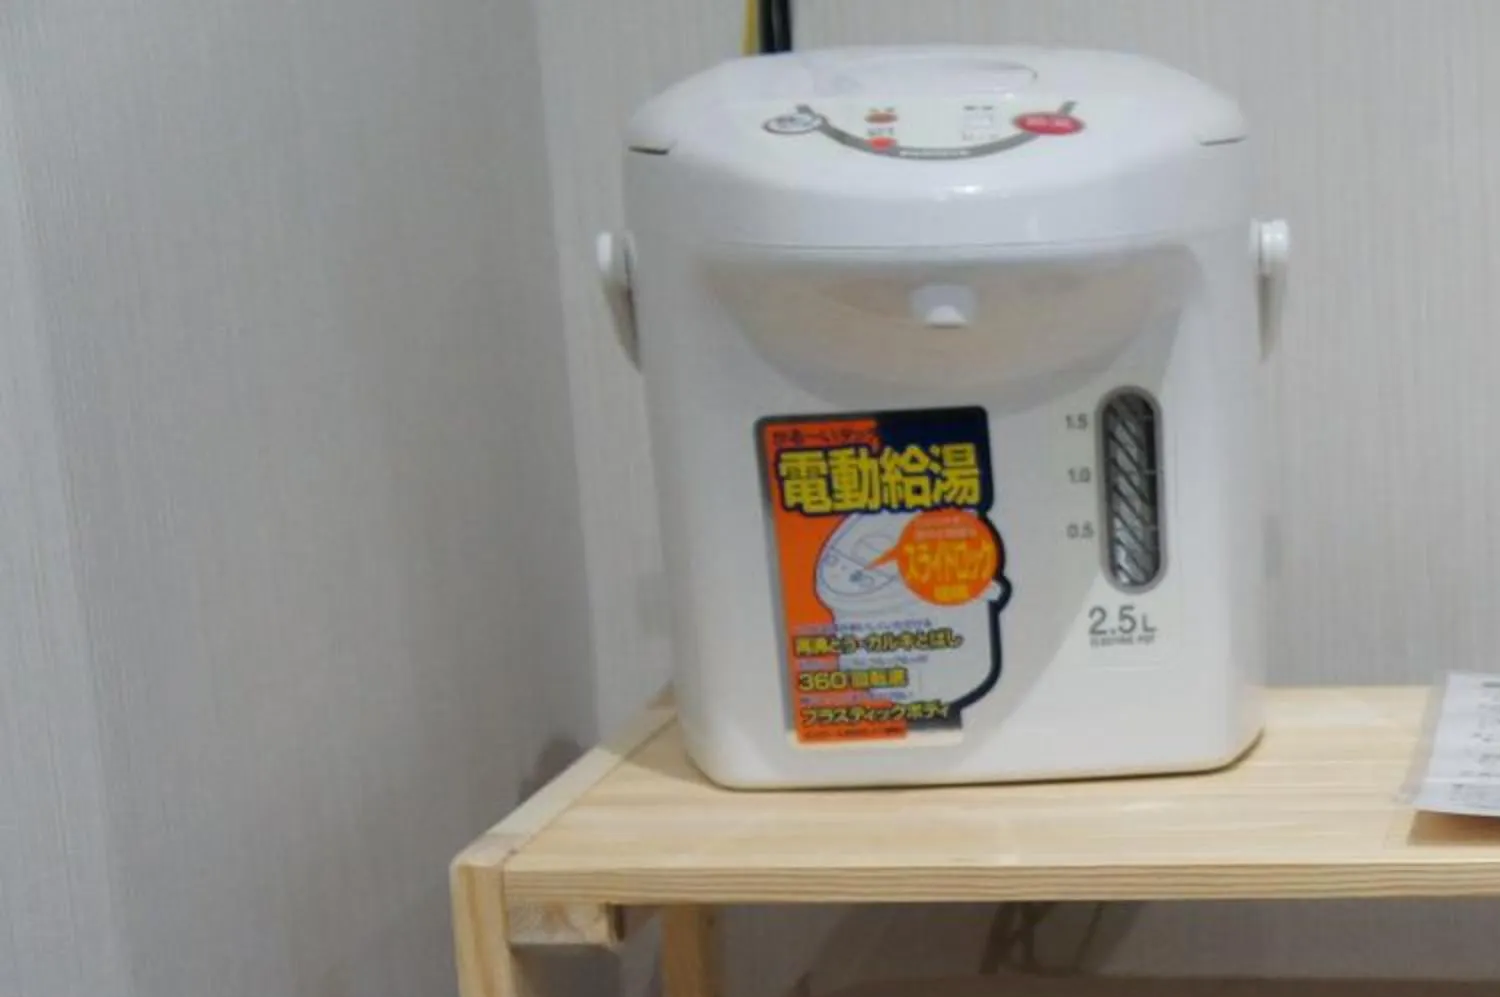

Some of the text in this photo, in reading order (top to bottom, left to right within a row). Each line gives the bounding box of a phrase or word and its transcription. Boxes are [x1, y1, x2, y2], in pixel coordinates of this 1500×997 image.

[1065, 414, 1088, 431] 1.5
[778, 442, 982, 514] 電動給湯
[1068, 467, 1091, 484] 1.0
[1066, 523, 1094, 540] 0.5
